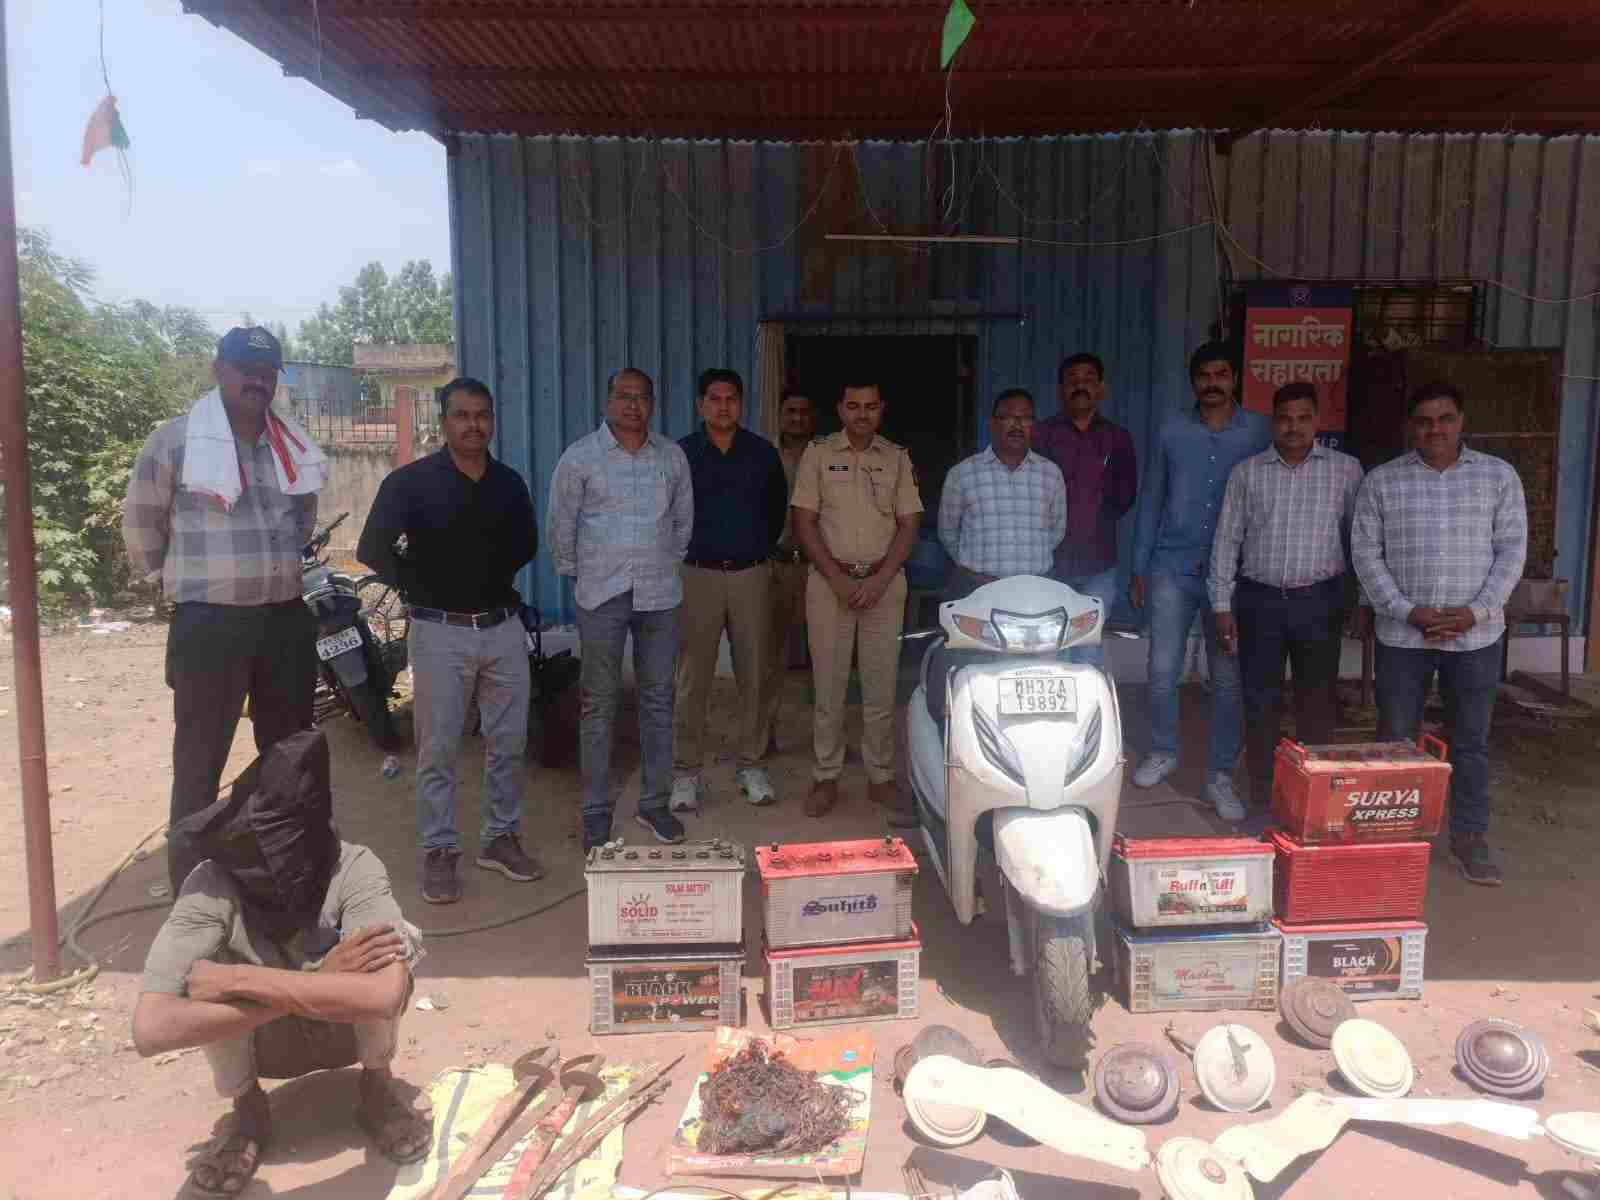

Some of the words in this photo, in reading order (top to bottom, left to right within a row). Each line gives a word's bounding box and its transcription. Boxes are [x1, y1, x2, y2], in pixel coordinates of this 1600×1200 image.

[1251, 316, 1345, 348] नागरिक
[1249, 359, 1343, 387] सहायता
[1344, 789, 1420, 807] SURYA
[1352, 807, 1419, 821] XPRESS
[620, 906, 658, 919] SOLID
[1332, 952, 1376, 968] BLACK
[624, 982, 689, 997] BLACK
